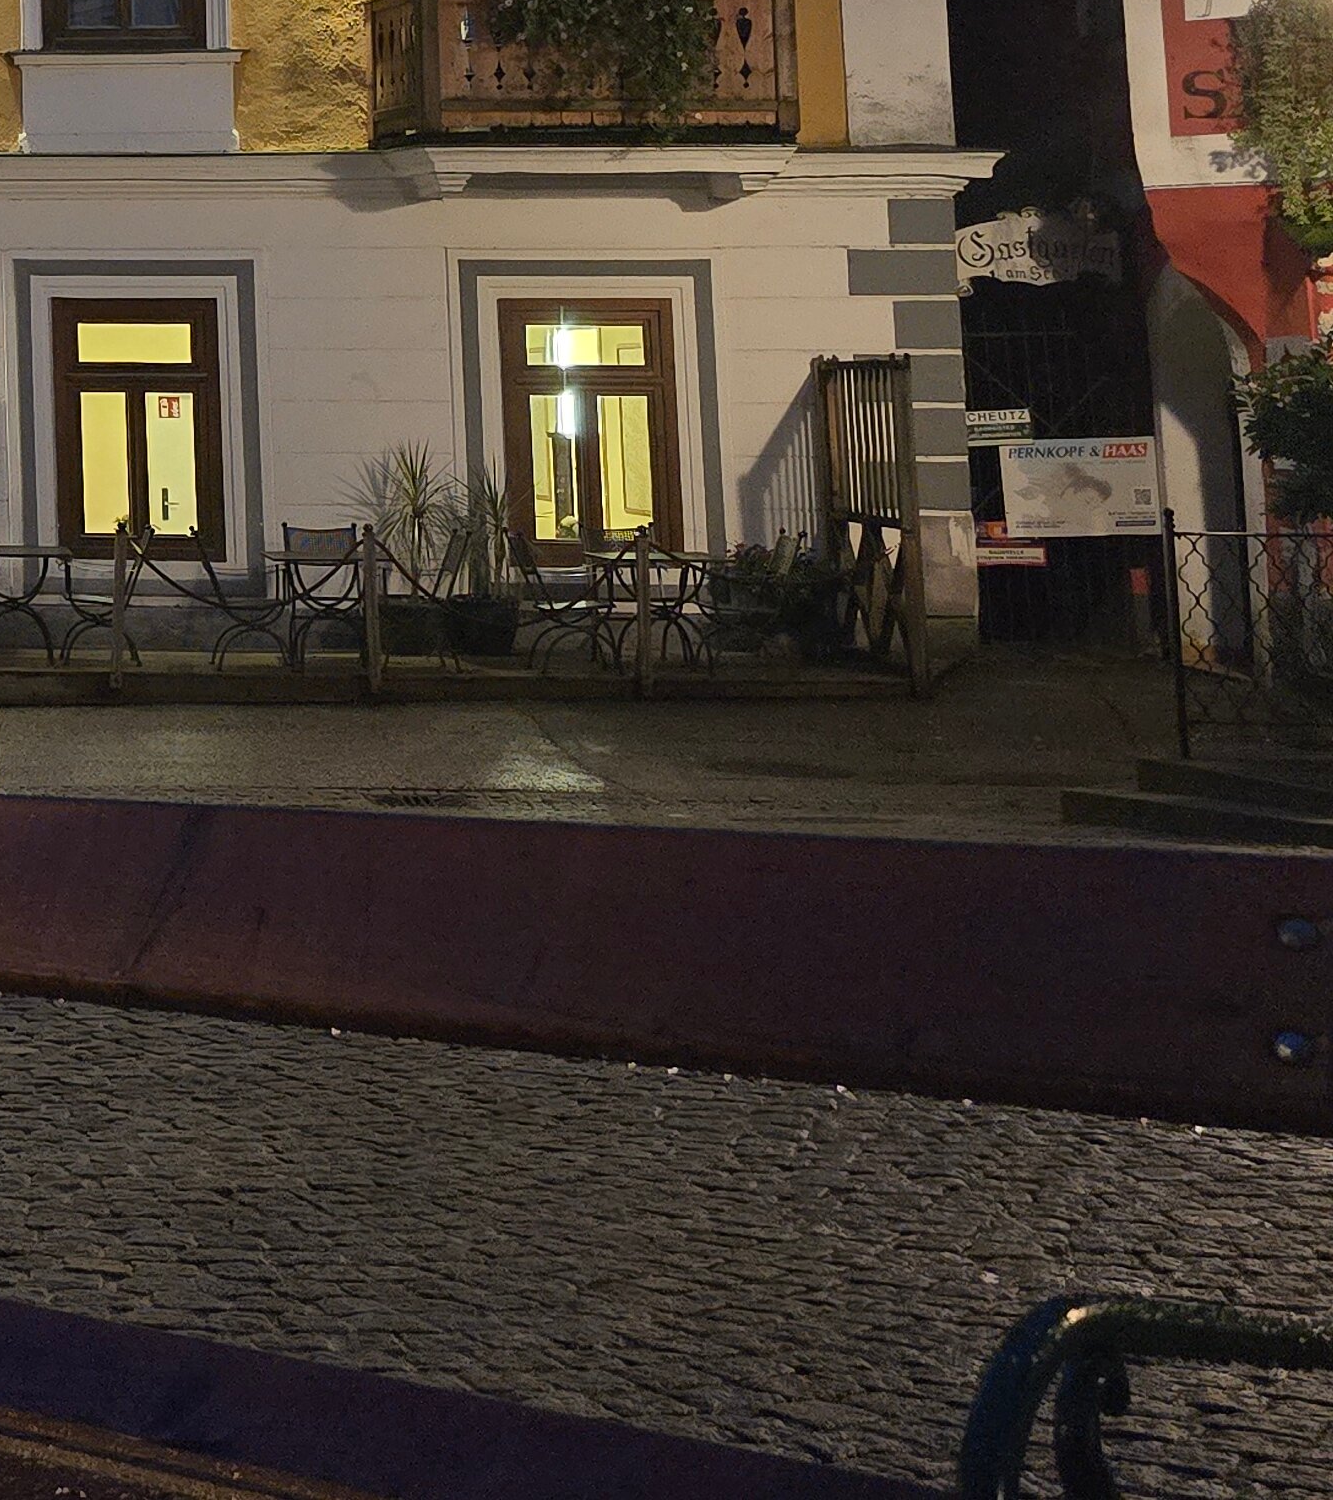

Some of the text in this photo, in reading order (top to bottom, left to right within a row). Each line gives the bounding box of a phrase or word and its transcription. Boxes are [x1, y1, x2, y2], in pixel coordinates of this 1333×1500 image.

[1008, 443, 1146, 459] PERNKOPF & HAAS
